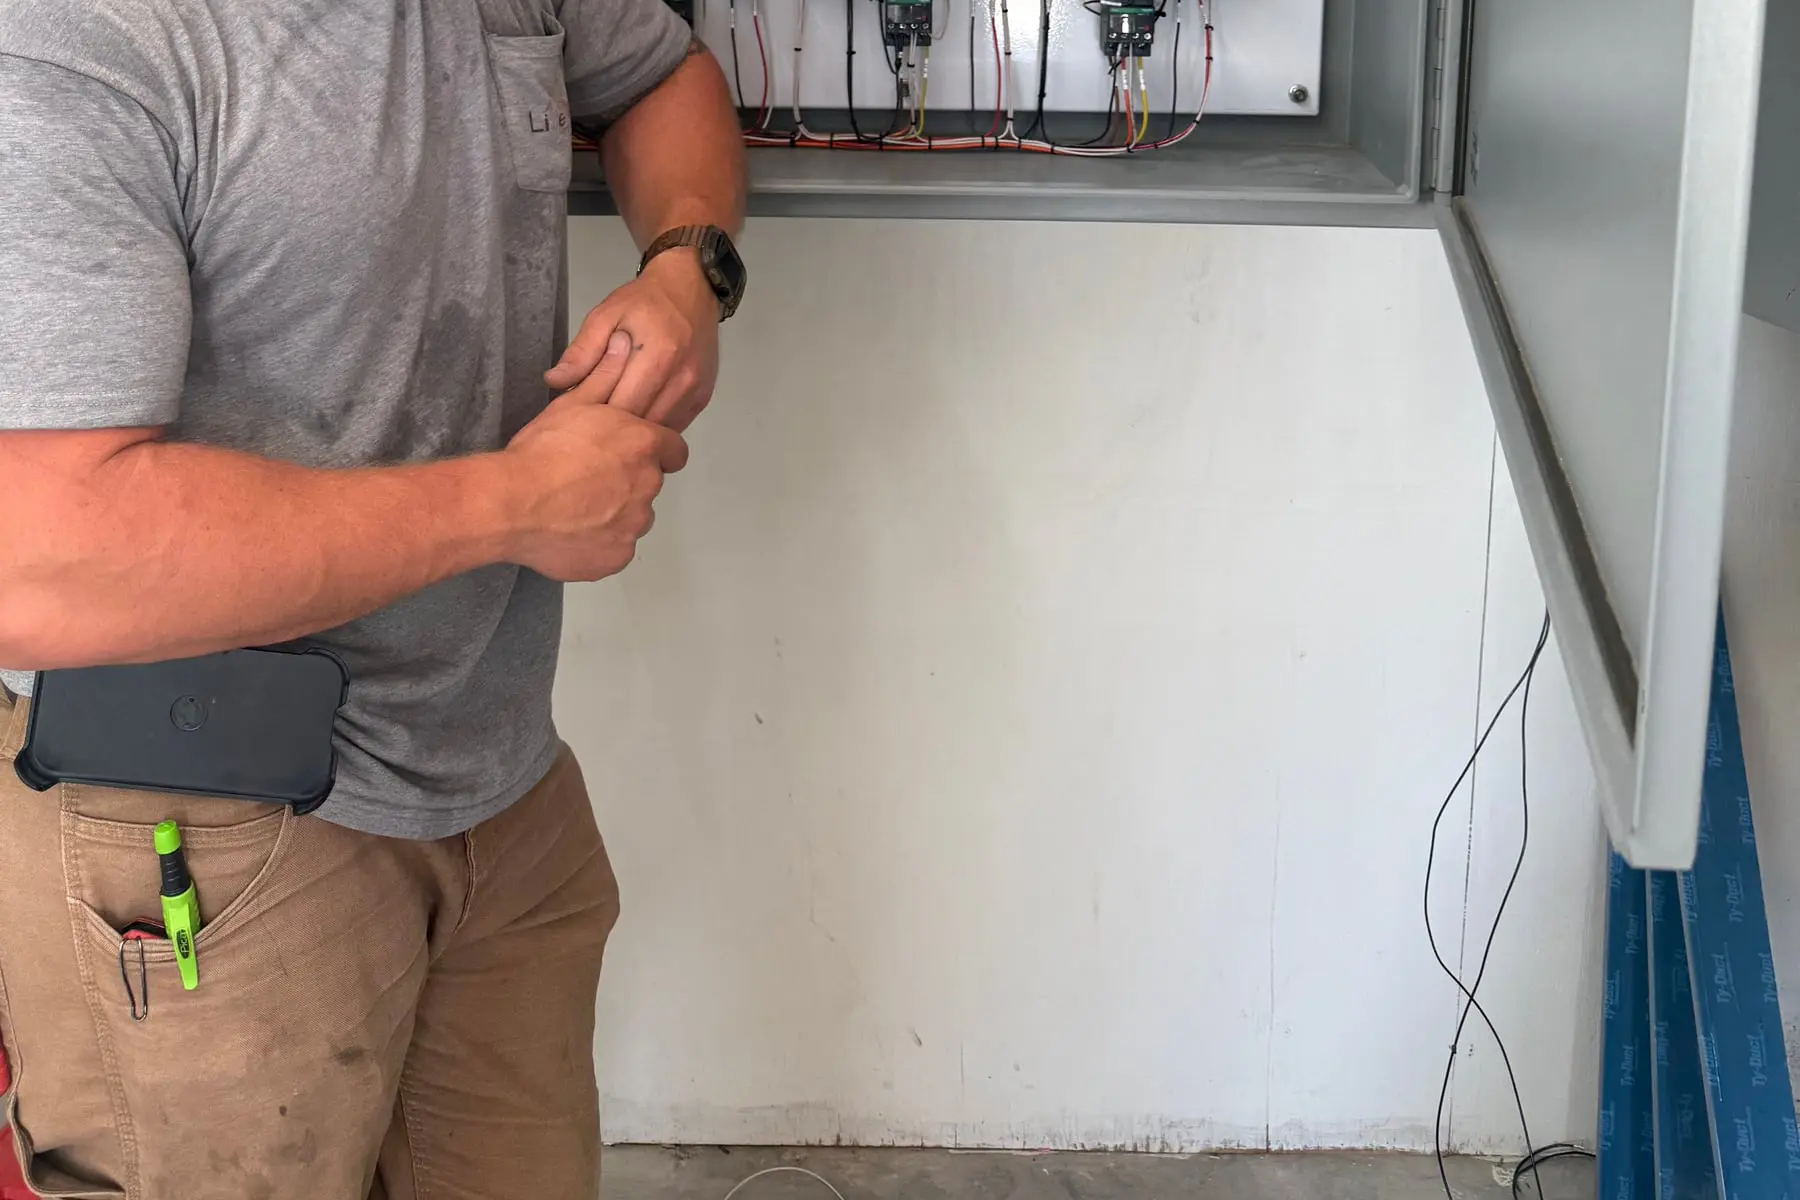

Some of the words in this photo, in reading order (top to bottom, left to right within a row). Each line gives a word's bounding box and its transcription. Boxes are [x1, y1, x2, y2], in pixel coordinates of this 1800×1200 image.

[1737, 797, 1753, 844] Ty-Duct
[1724, 873, 1743, 922] Ty-Duct
[1625, 913, 1639, 953] Ty-Duct
[1712, 954, 1731, 1004] Ty-Duct
[1759, 952, 1777, 1003] Ty-Duct
[1621, 1044, 1634, 1086] Ty-Duct
[1747, 1034, 1767, 1087] Ty-Duct
[1734, 1118, 1755, 1173] Ty-Duct
